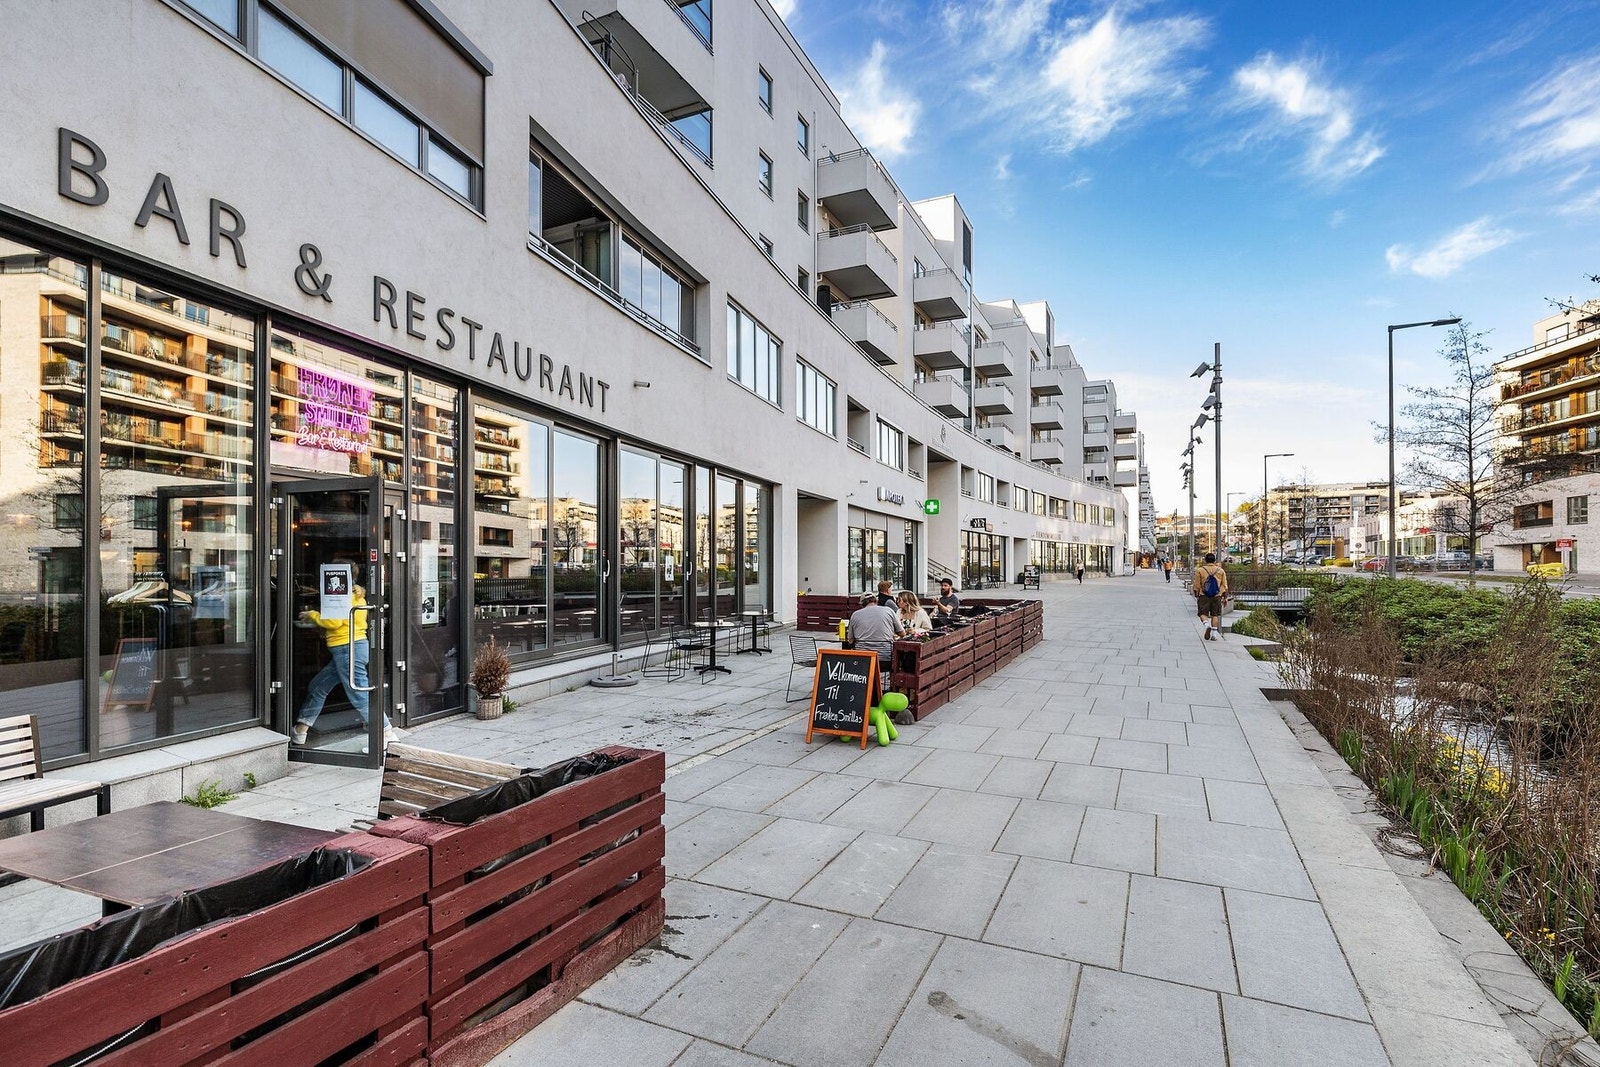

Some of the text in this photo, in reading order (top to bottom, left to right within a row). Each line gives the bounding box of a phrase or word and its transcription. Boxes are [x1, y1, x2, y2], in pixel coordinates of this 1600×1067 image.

[58, 127, 611, 412] BAR & RESTAURANT
[305, 399, 368, 434] SMILLAS
[298, 425, 318, 445] Bar
[328, 430, 373, 453] Restaurant
[827, 661, 867, 684] Velkommen
[825, 685, 839, 700] Til
[838, 709, 863, 723] Smillas
